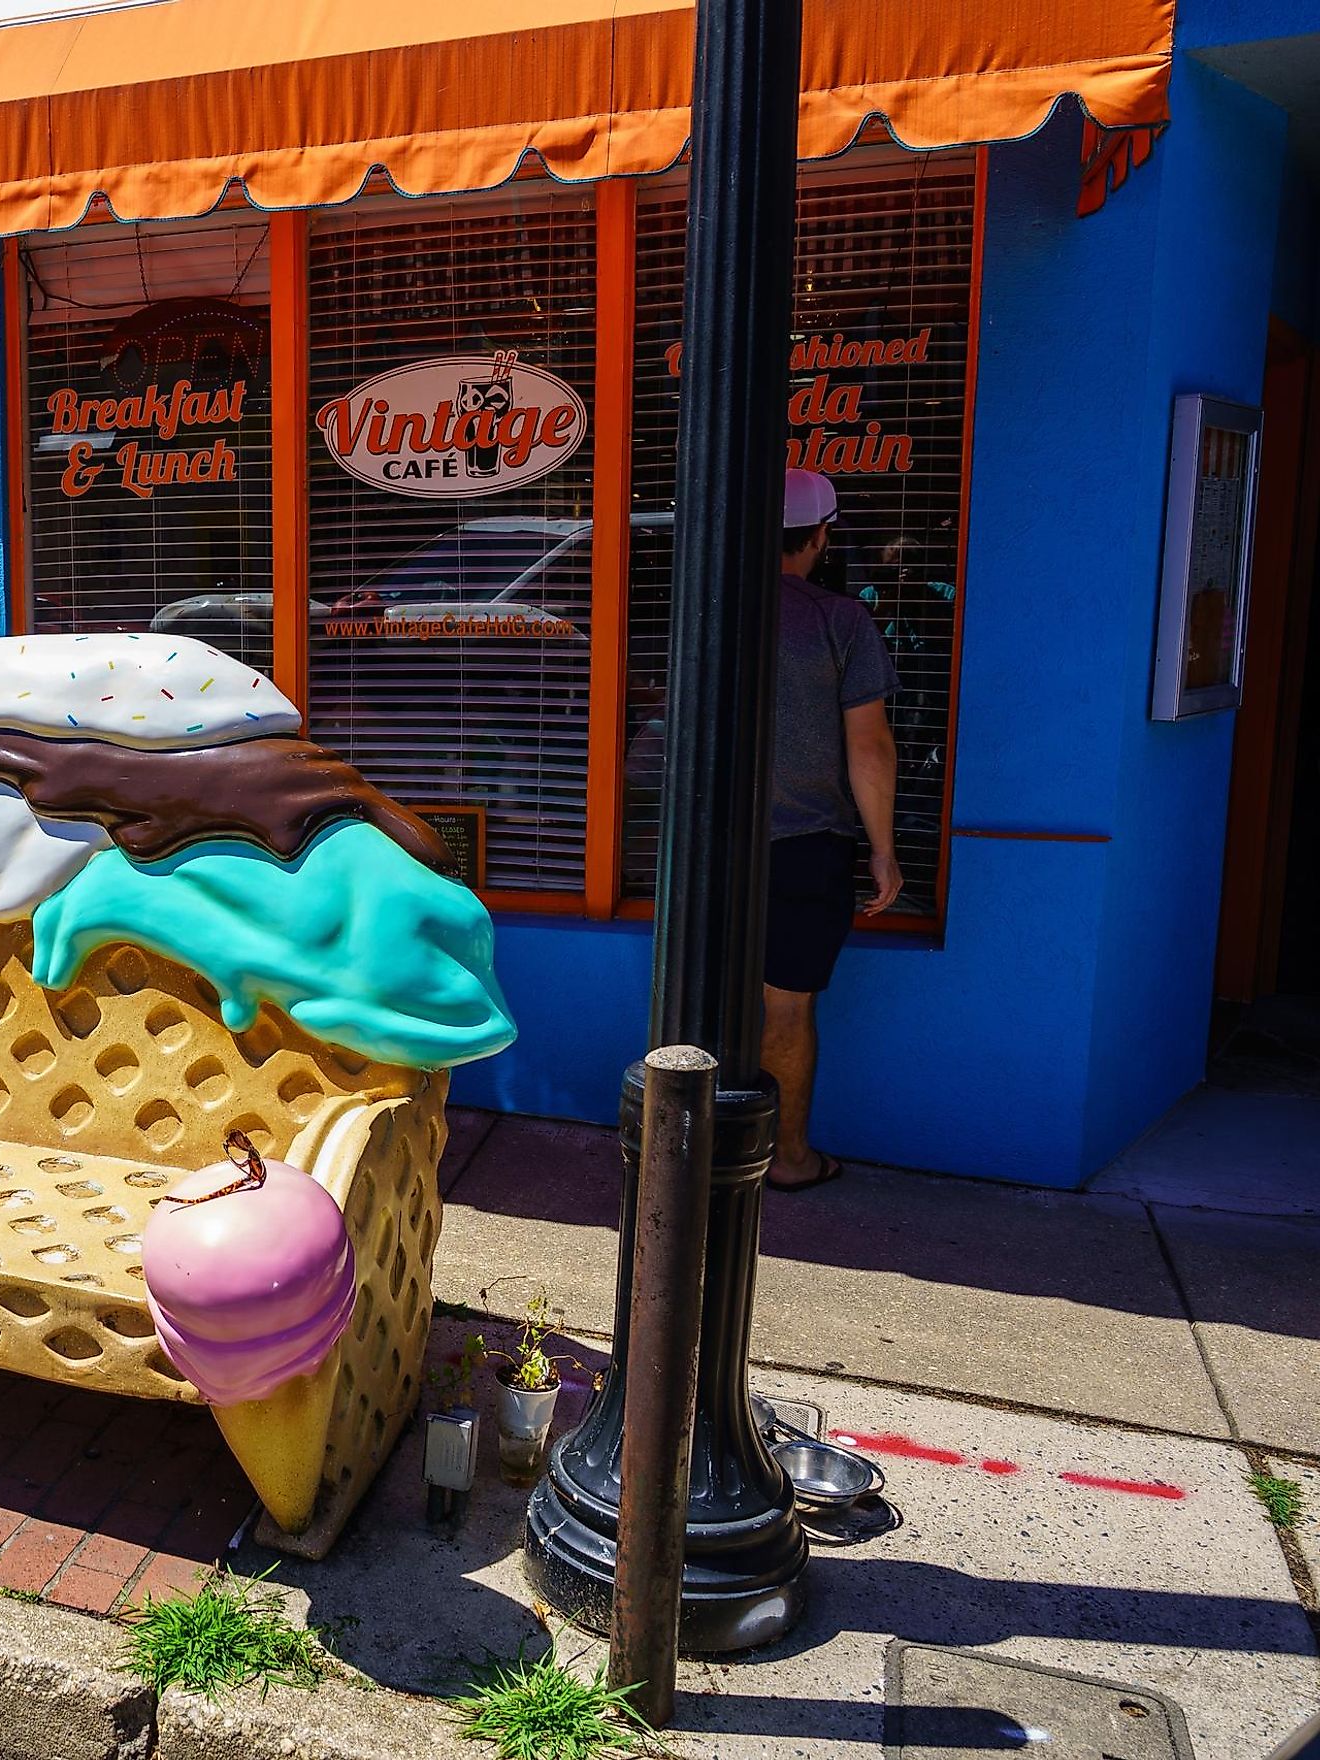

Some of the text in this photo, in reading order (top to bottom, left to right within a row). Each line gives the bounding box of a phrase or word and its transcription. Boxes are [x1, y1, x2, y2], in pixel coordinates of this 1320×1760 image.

[114, 330, 263, 387] OPEN
[47, 379, 247, 440] Breakfast
[316, 397, 577, 468] Vintage
[61, 438, 236, 498] & Lunch
[383, 452, 459, 480] CAFÉ
[325, 614, 573, 640] www.VintageCafeHdG.com
